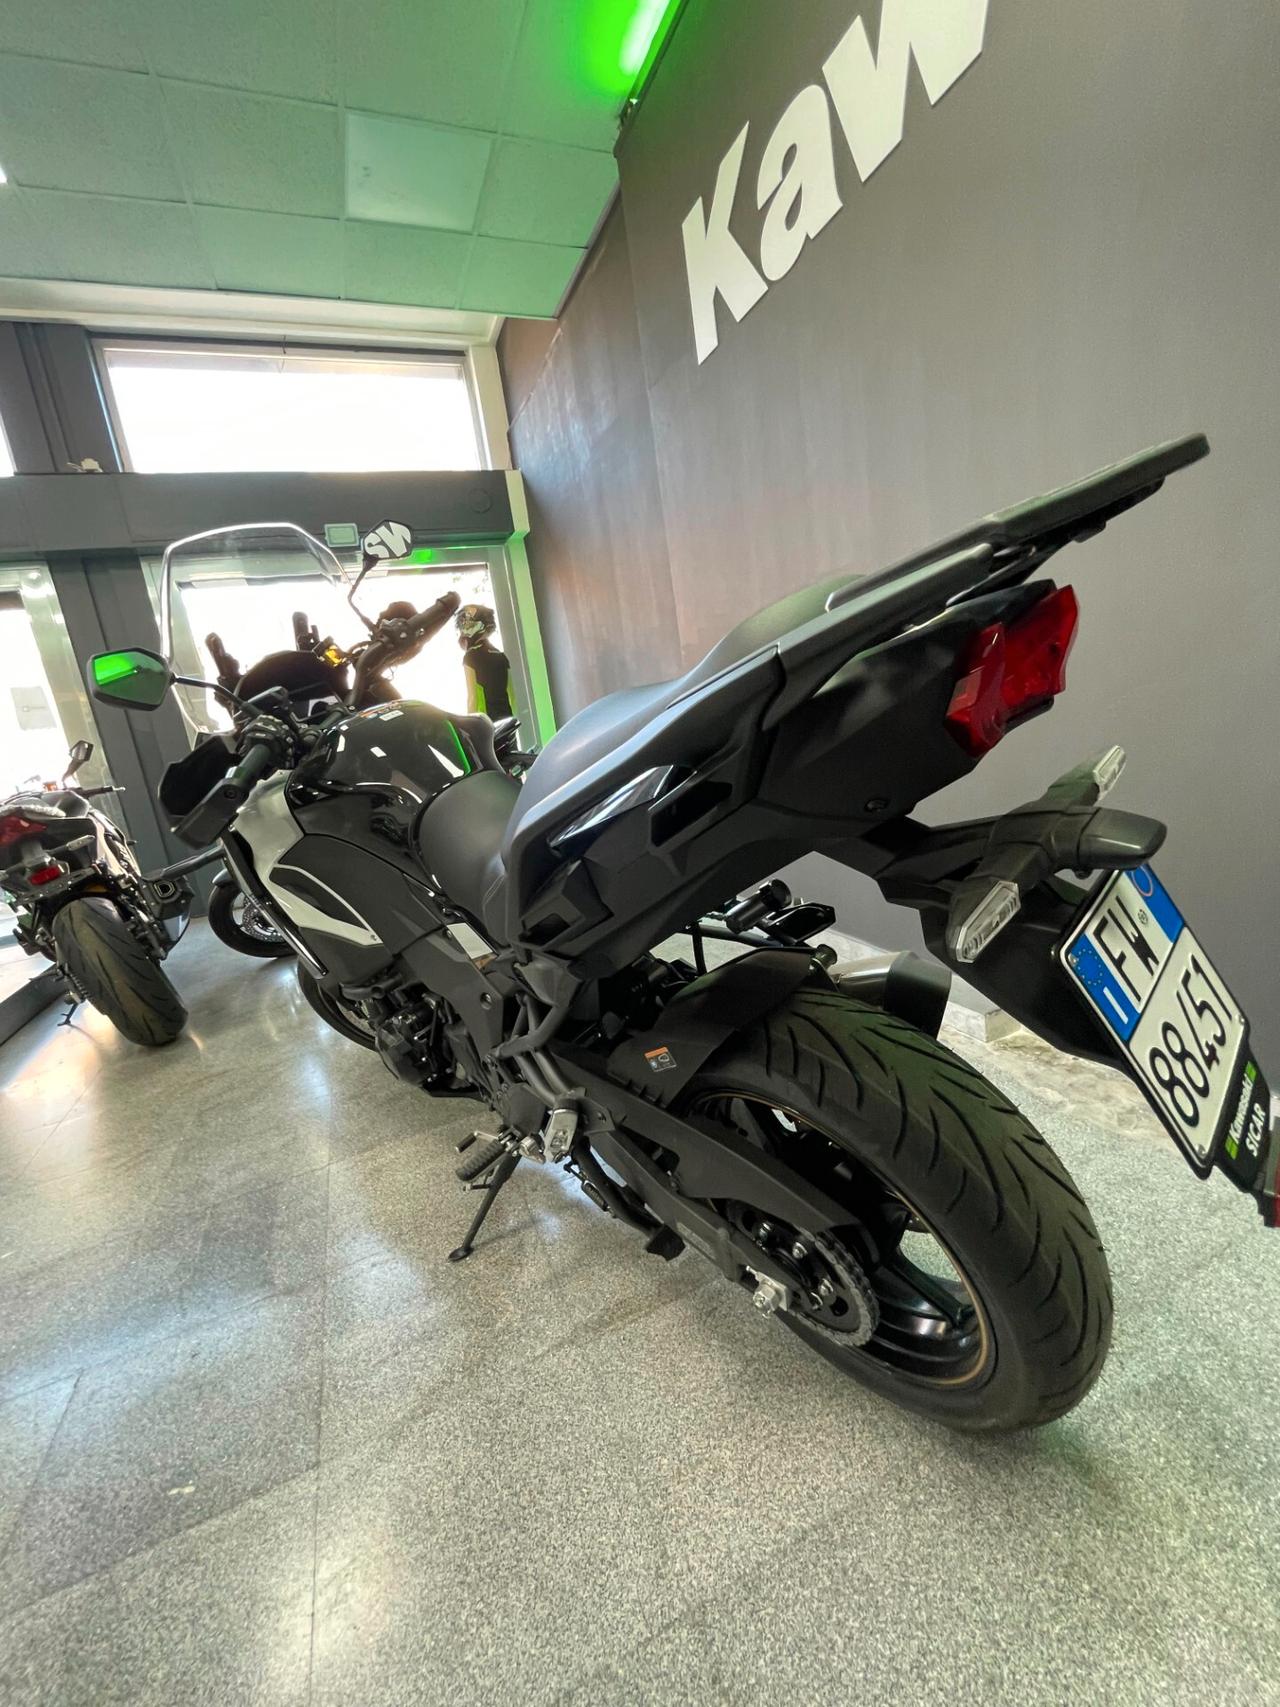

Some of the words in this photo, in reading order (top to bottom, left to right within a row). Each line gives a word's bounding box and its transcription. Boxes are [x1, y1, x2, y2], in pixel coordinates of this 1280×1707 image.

[1093, 896, 1159, 1002] FW
[1149, 954, 1232, 1127] 88451
[1229, 1073, 1253, 1144] Kawasaki
[1245, 1103, 1266, 1157] SICAR
